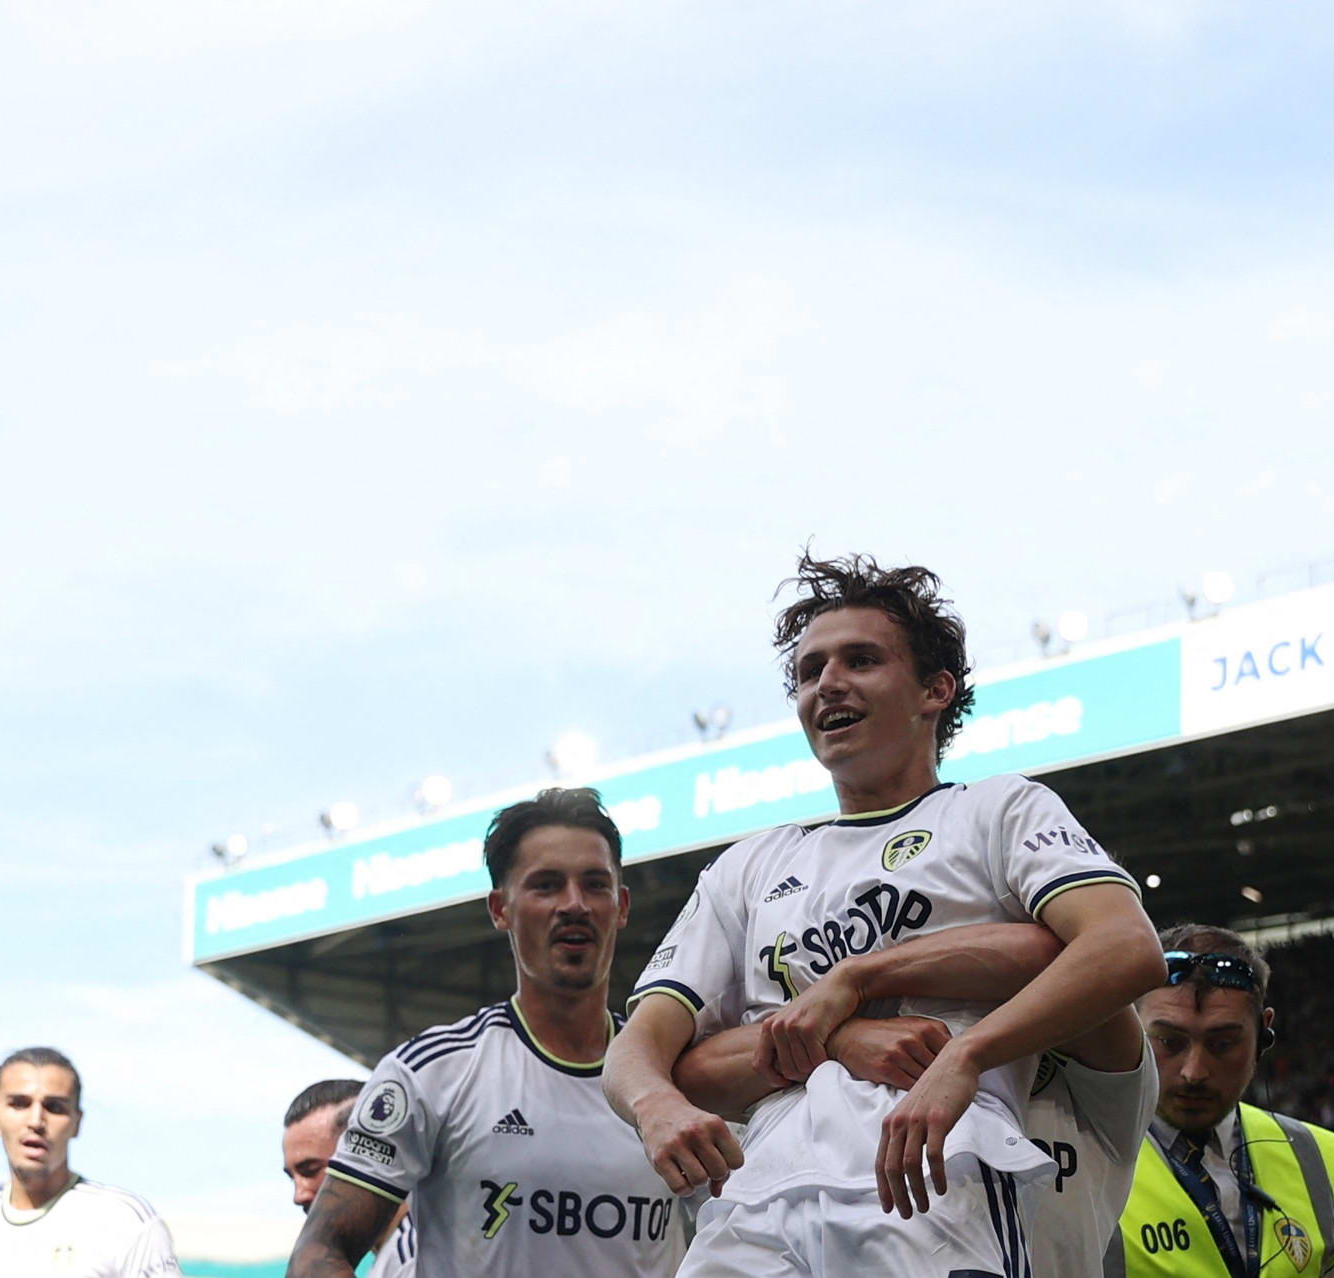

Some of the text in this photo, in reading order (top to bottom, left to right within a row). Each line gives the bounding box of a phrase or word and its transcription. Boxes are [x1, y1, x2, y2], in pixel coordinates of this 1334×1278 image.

[1210, 633, 1325, 692] JACK
[492, 1123, 534, 1136] adidas
[1141, 1218, 1191, 1255] 006
